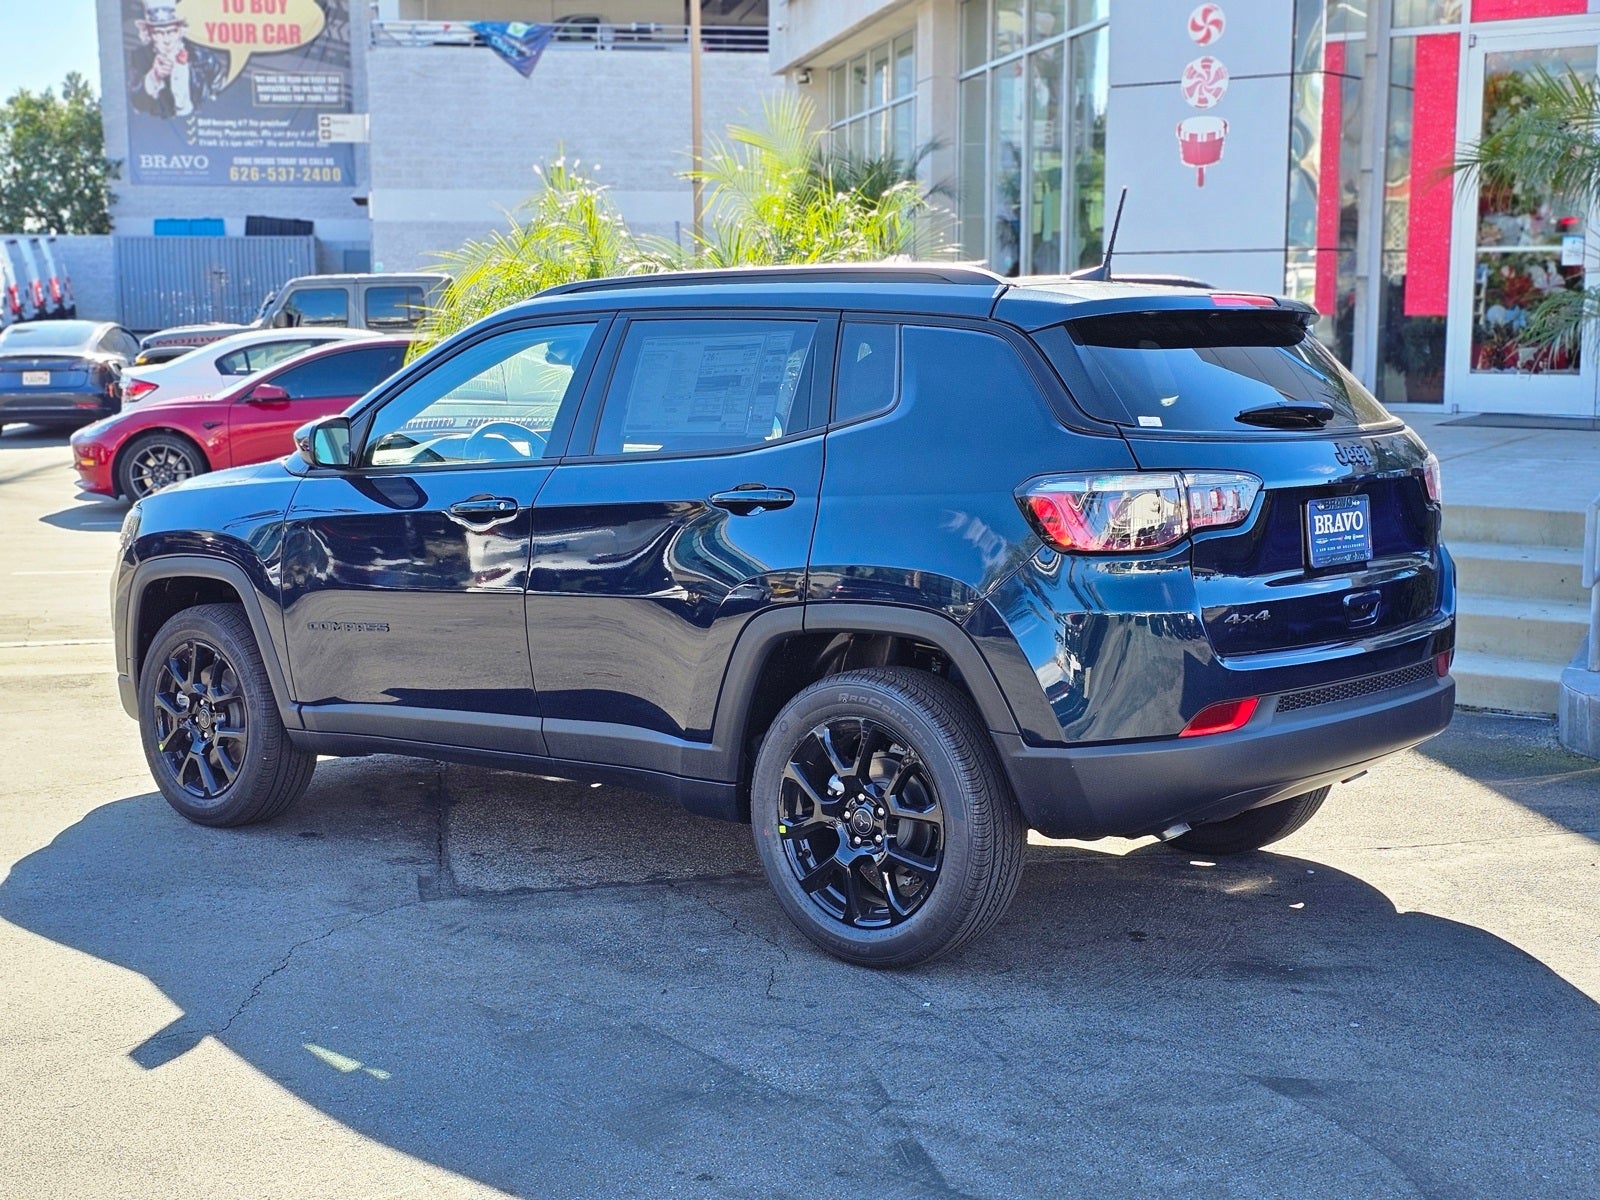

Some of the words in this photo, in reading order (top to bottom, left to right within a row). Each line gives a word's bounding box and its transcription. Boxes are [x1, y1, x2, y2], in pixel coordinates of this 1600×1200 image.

[221, 0, 245, 14] TO
[250, 0, 289, 15] BUY
[205, 21, 258, 44] YOUR
[262, 23, 302, 45] CAR
[139, 154, 209, 170] BRAVO
[229, 166, 342, 182] 626-537-2400
[1334, 442, 1373, 467] Jeep
[1314, 510, 1364, 535] BRAVO
[307, 621, 390, 633] COMPASS
